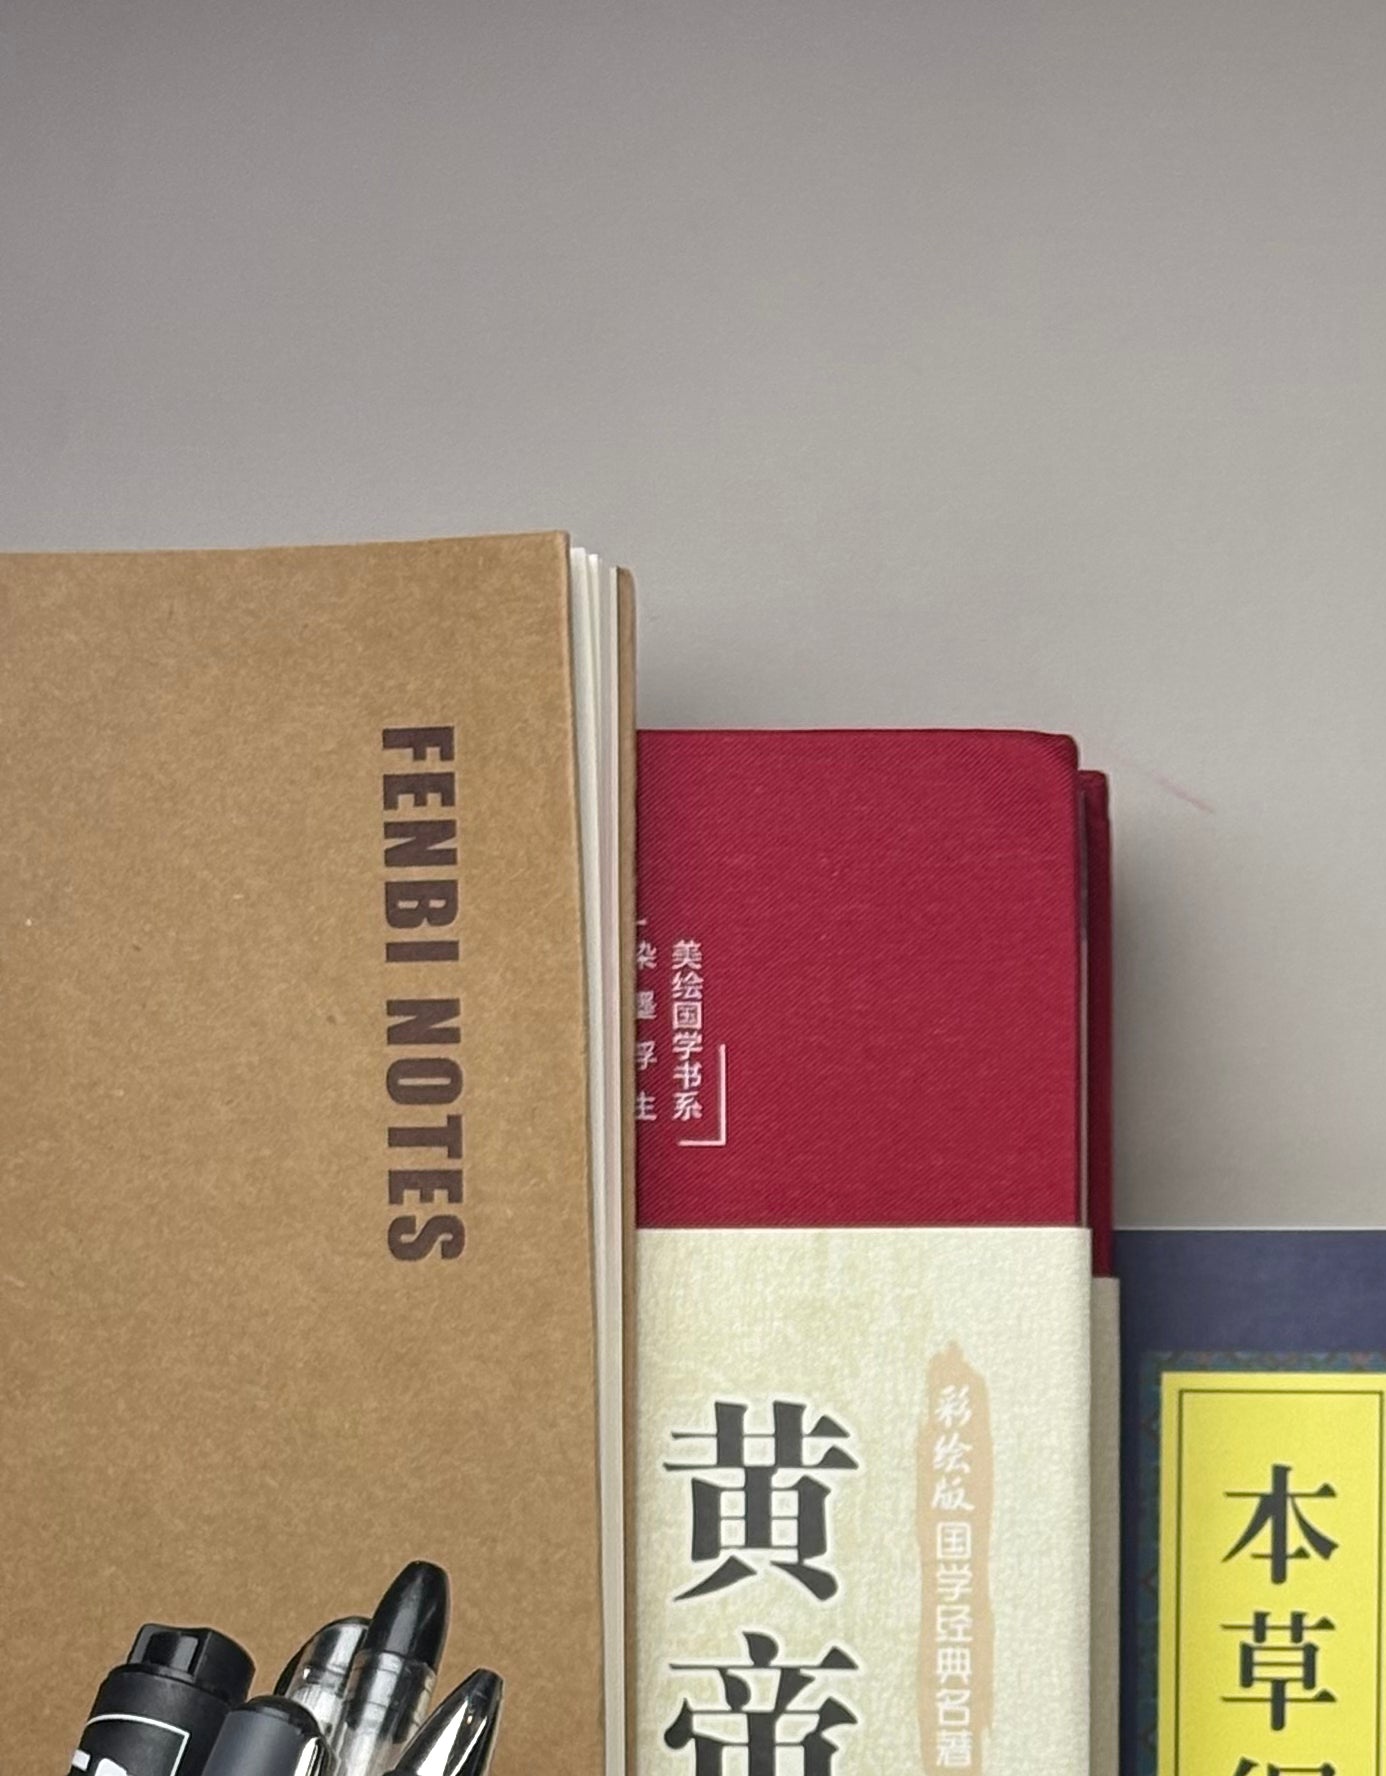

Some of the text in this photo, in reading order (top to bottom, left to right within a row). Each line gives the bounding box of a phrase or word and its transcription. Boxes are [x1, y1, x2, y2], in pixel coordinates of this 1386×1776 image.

[382, 726, 465, 1261] FENBI NOTES
[672, 939, 704, 1121] 美绘国学书系
